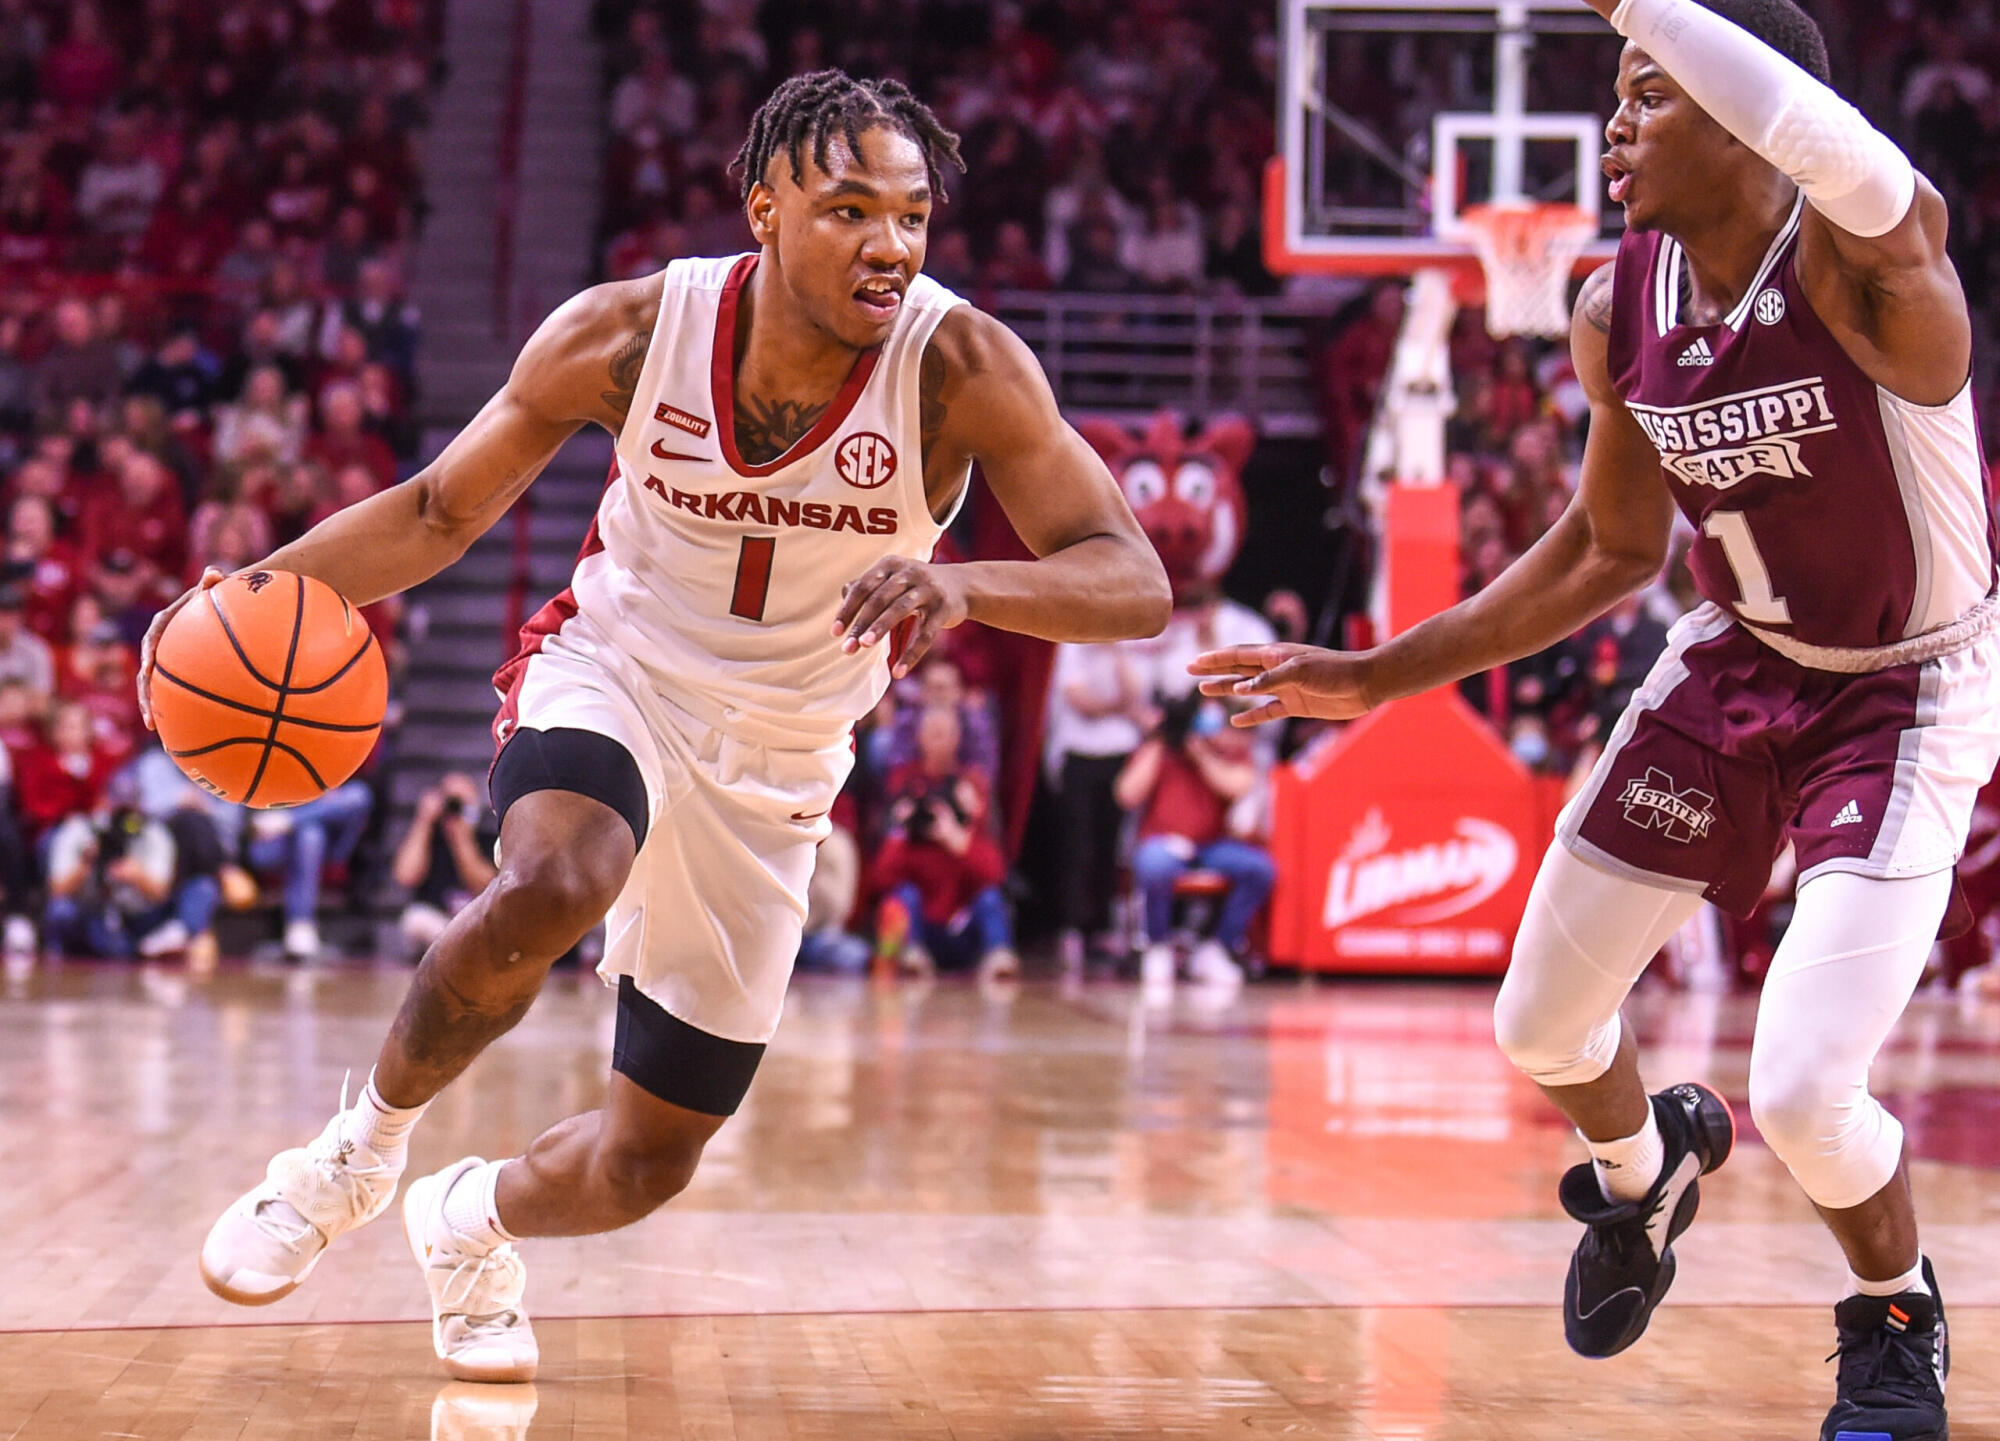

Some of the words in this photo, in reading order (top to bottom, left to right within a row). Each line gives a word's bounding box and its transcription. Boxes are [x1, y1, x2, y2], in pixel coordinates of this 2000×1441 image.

[1759, 291, 1783, 323] SEC
[1677, 354, 1714, 367] adidas
[840, 436, 891, 486] SEC
[643, 472, 898, 535] ARKANSAS
[729, 535, 776, 622] 1
[1703, 510, 1793, 624] 1
[1639, 790, 1698, 825] STATE
